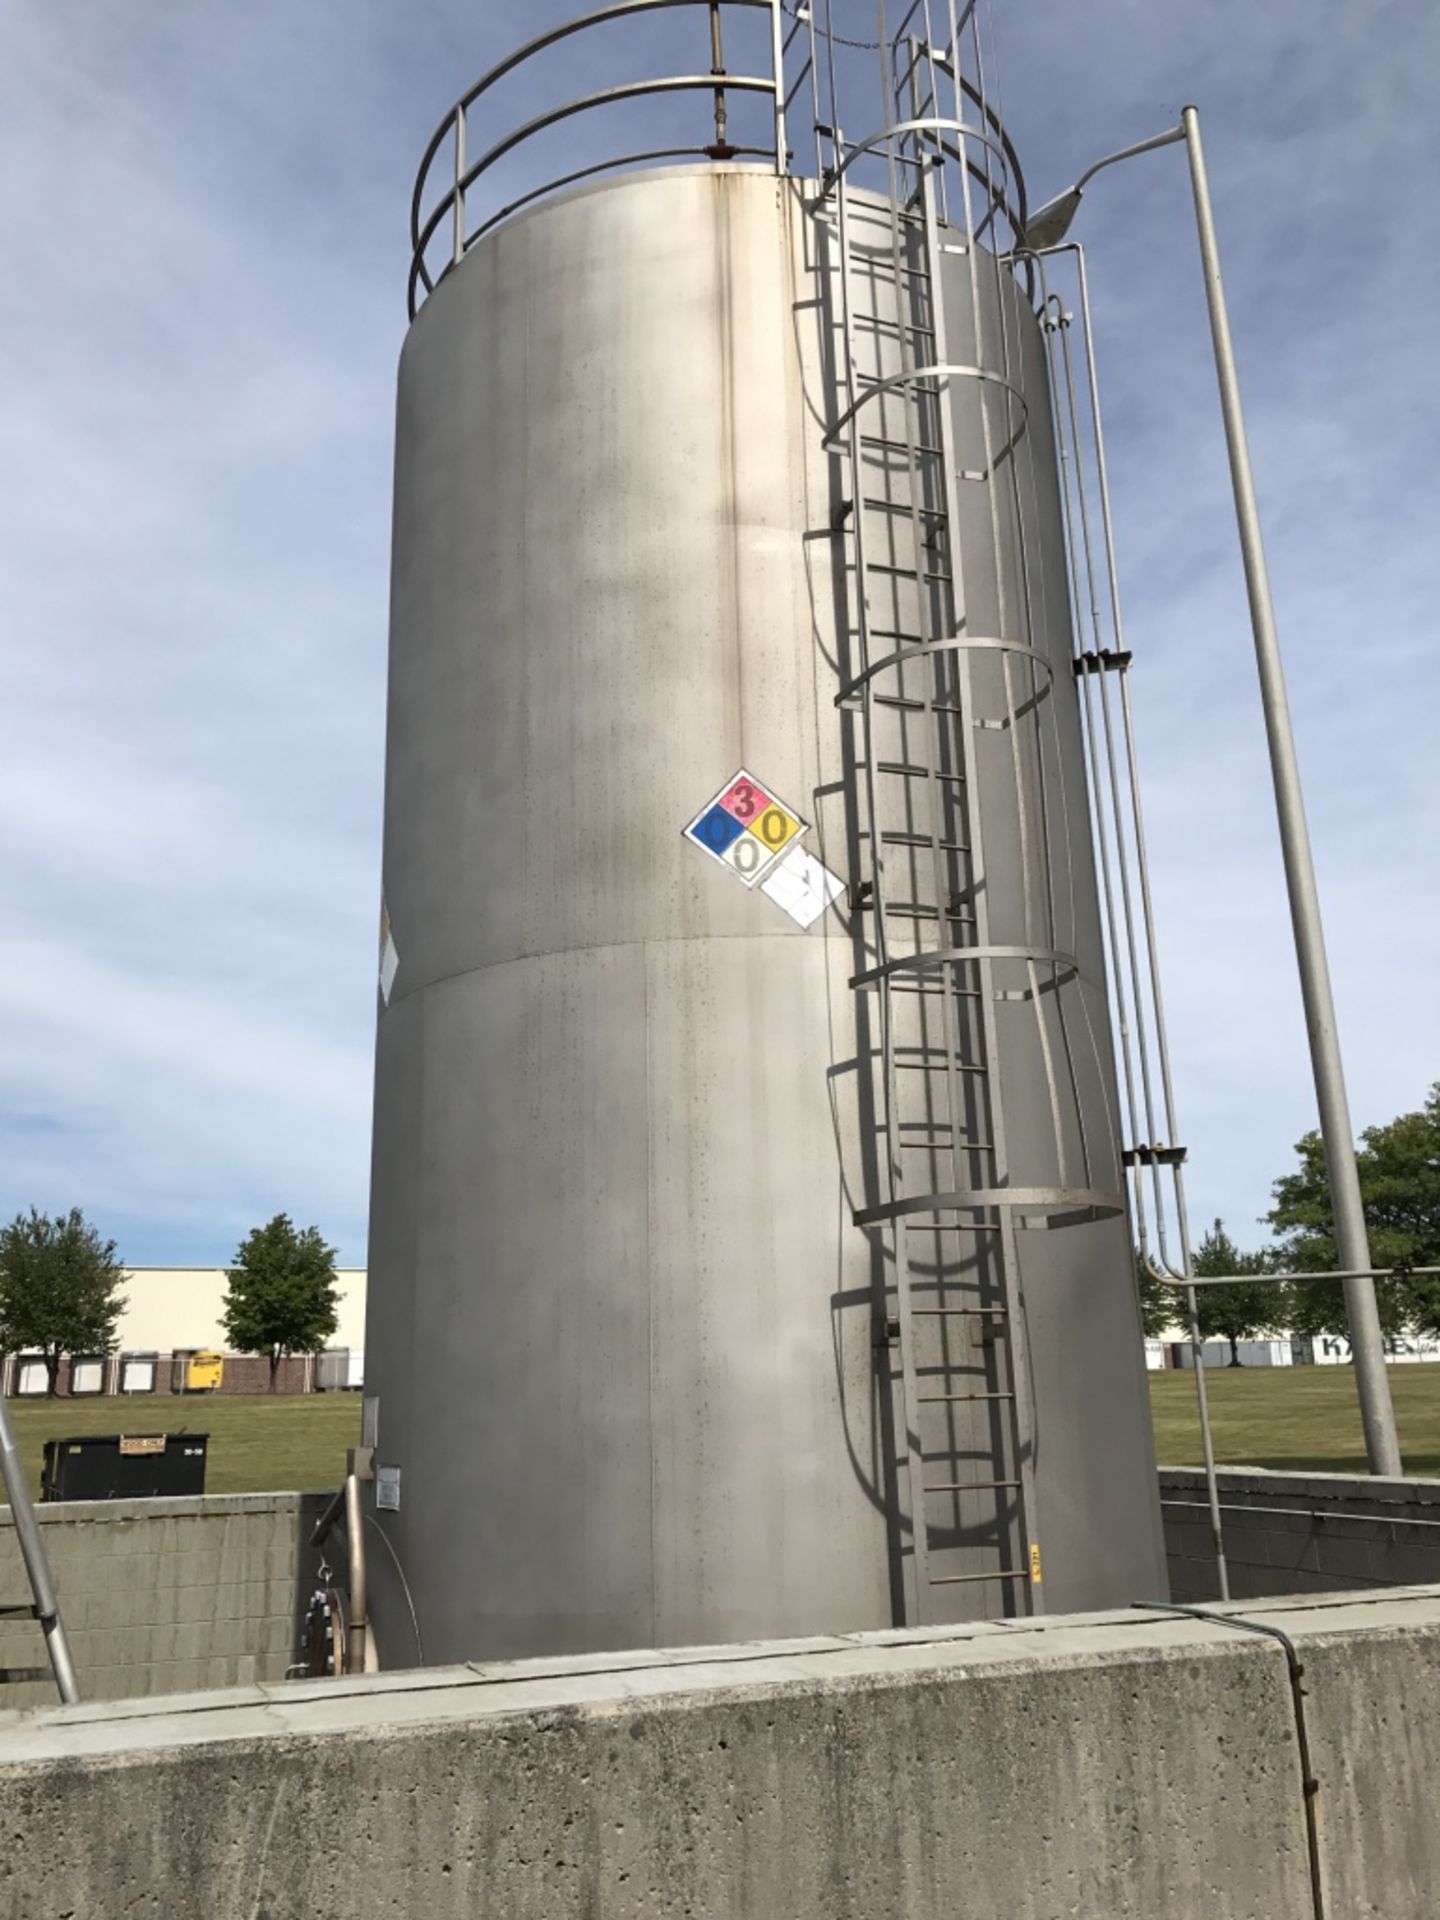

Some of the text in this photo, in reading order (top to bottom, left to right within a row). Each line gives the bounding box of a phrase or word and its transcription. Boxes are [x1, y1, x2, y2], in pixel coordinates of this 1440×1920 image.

[733, 785, 755, 818] 3
[704, 812, 729, 845] 0
[762, 810, 788, 844] 0
[733, 838, 760, 873] 0
